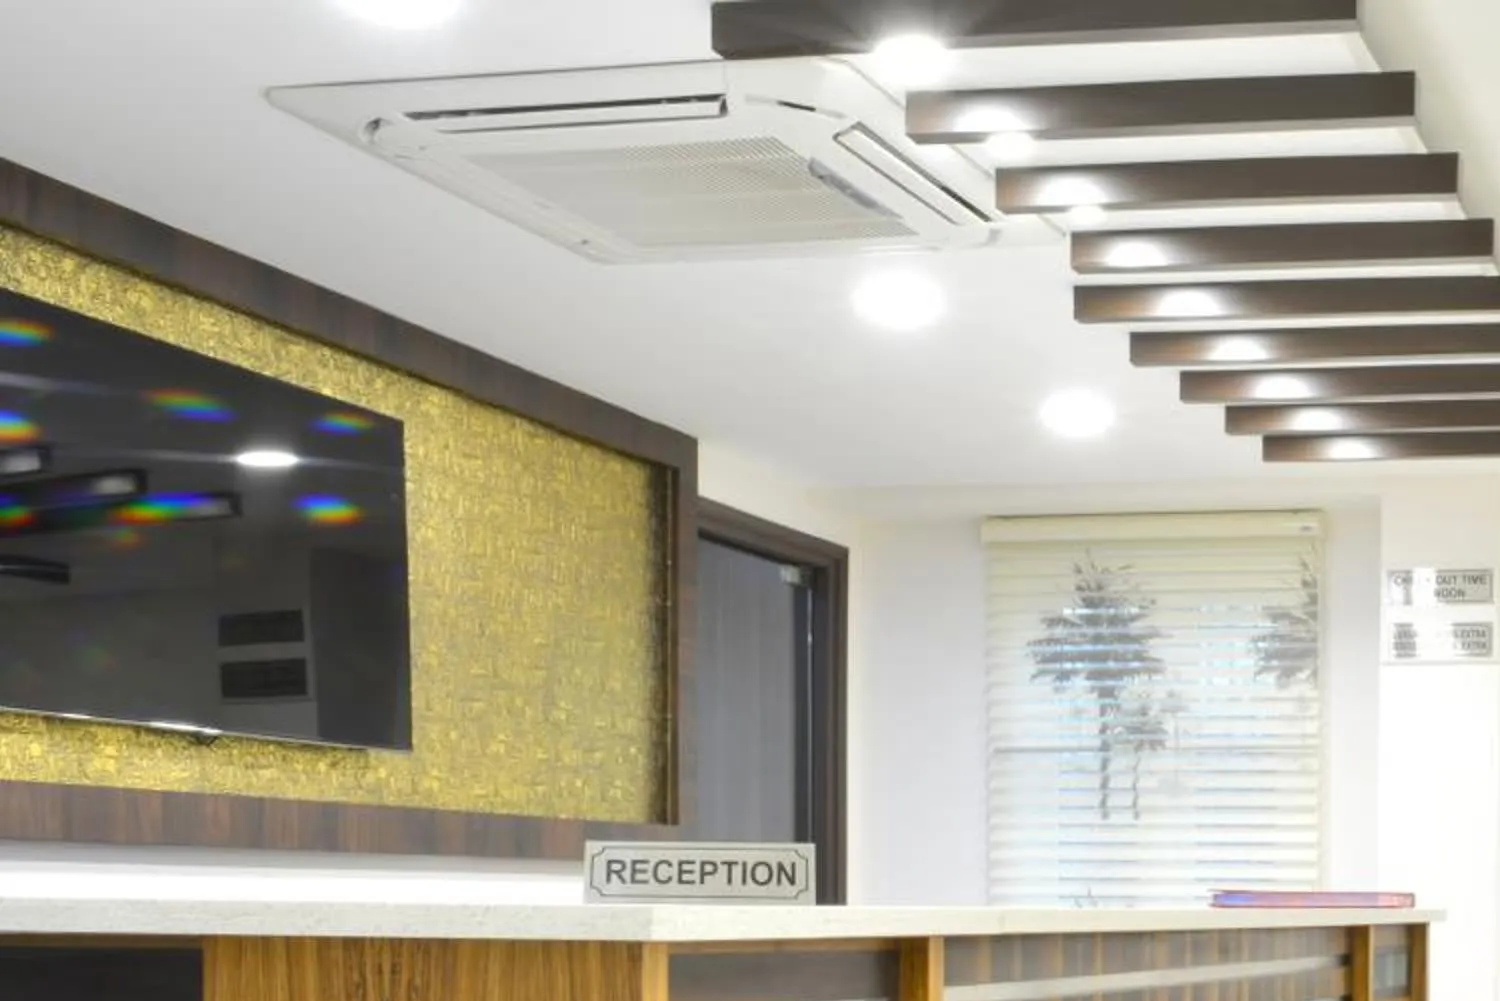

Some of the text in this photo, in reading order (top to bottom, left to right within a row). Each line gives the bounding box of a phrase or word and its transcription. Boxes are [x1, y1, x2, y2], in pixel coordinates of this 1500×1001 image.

[1435, 574, 1488, 586] OUT TIME
[605, 858, 797, 887] RECEPTION
